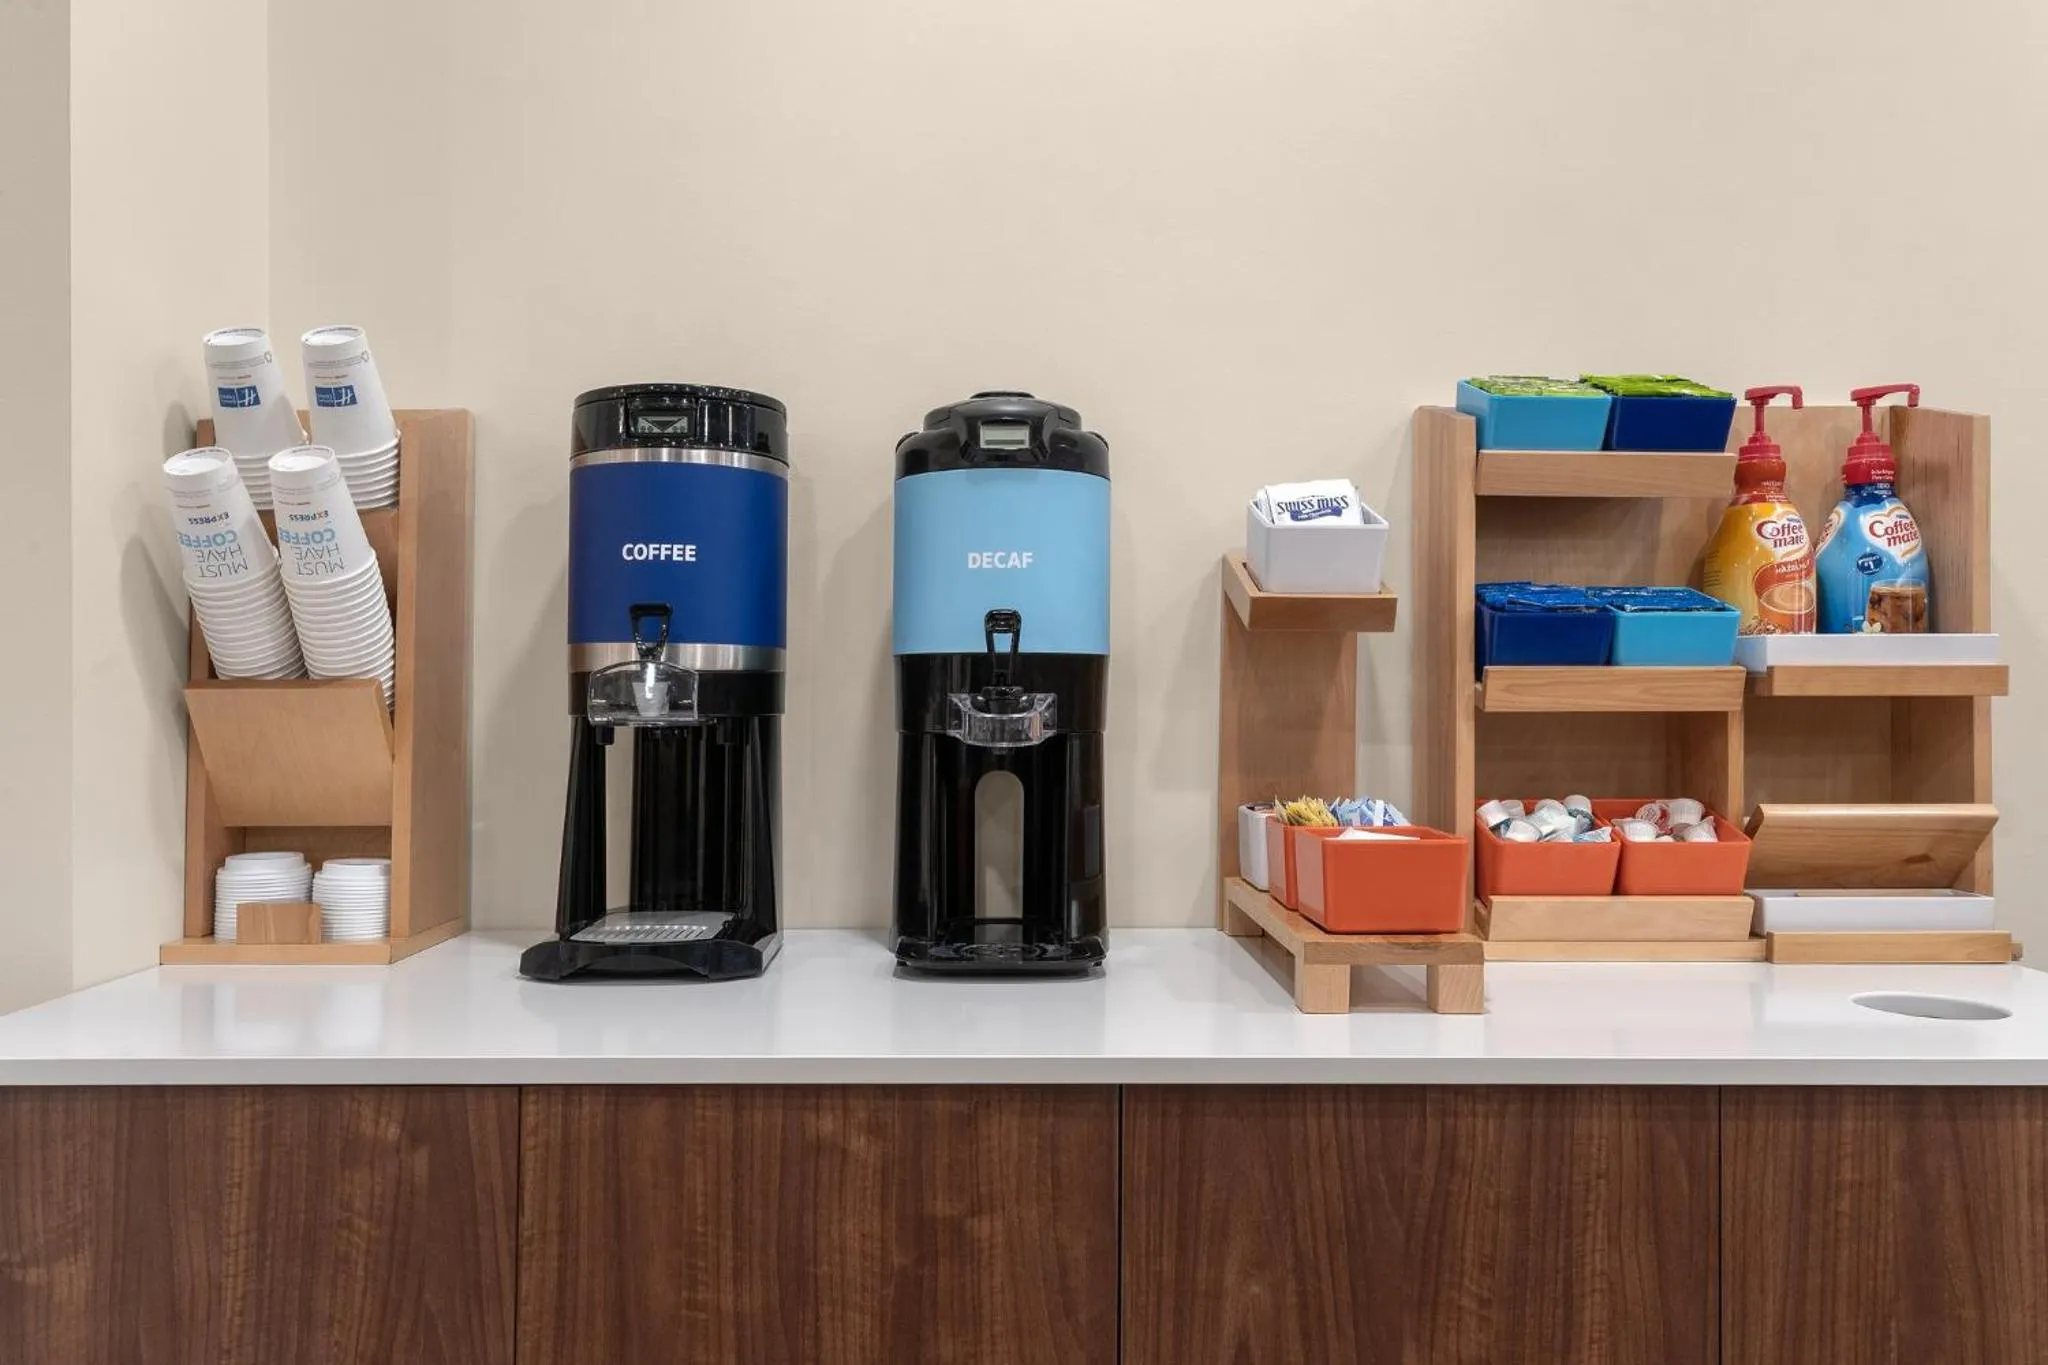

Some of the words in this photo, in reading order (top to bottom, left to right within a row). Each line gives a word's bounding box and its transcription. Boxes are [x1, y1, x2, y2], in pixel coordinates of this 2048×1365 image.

[188, 511, 230, 525] EXPRESS
[289, 510, 329, 524] EXPRESS
[1756, 519, 1803, 540] Coffee
[1869, 519, 1915, 538] Coffee
[1773, 534, 1804, 549] mate
[1886, 530, 1919, 547] mate
[196, 544, 243, 563] HAVE
[294, 543, 340, 561] HAVE
[622, 543, 697, 563] COFFEE
[967, 551, 1034, 569] DECAF
[199, 557, 248, 578] MUST
[297, 557, 344, 576] MUST
